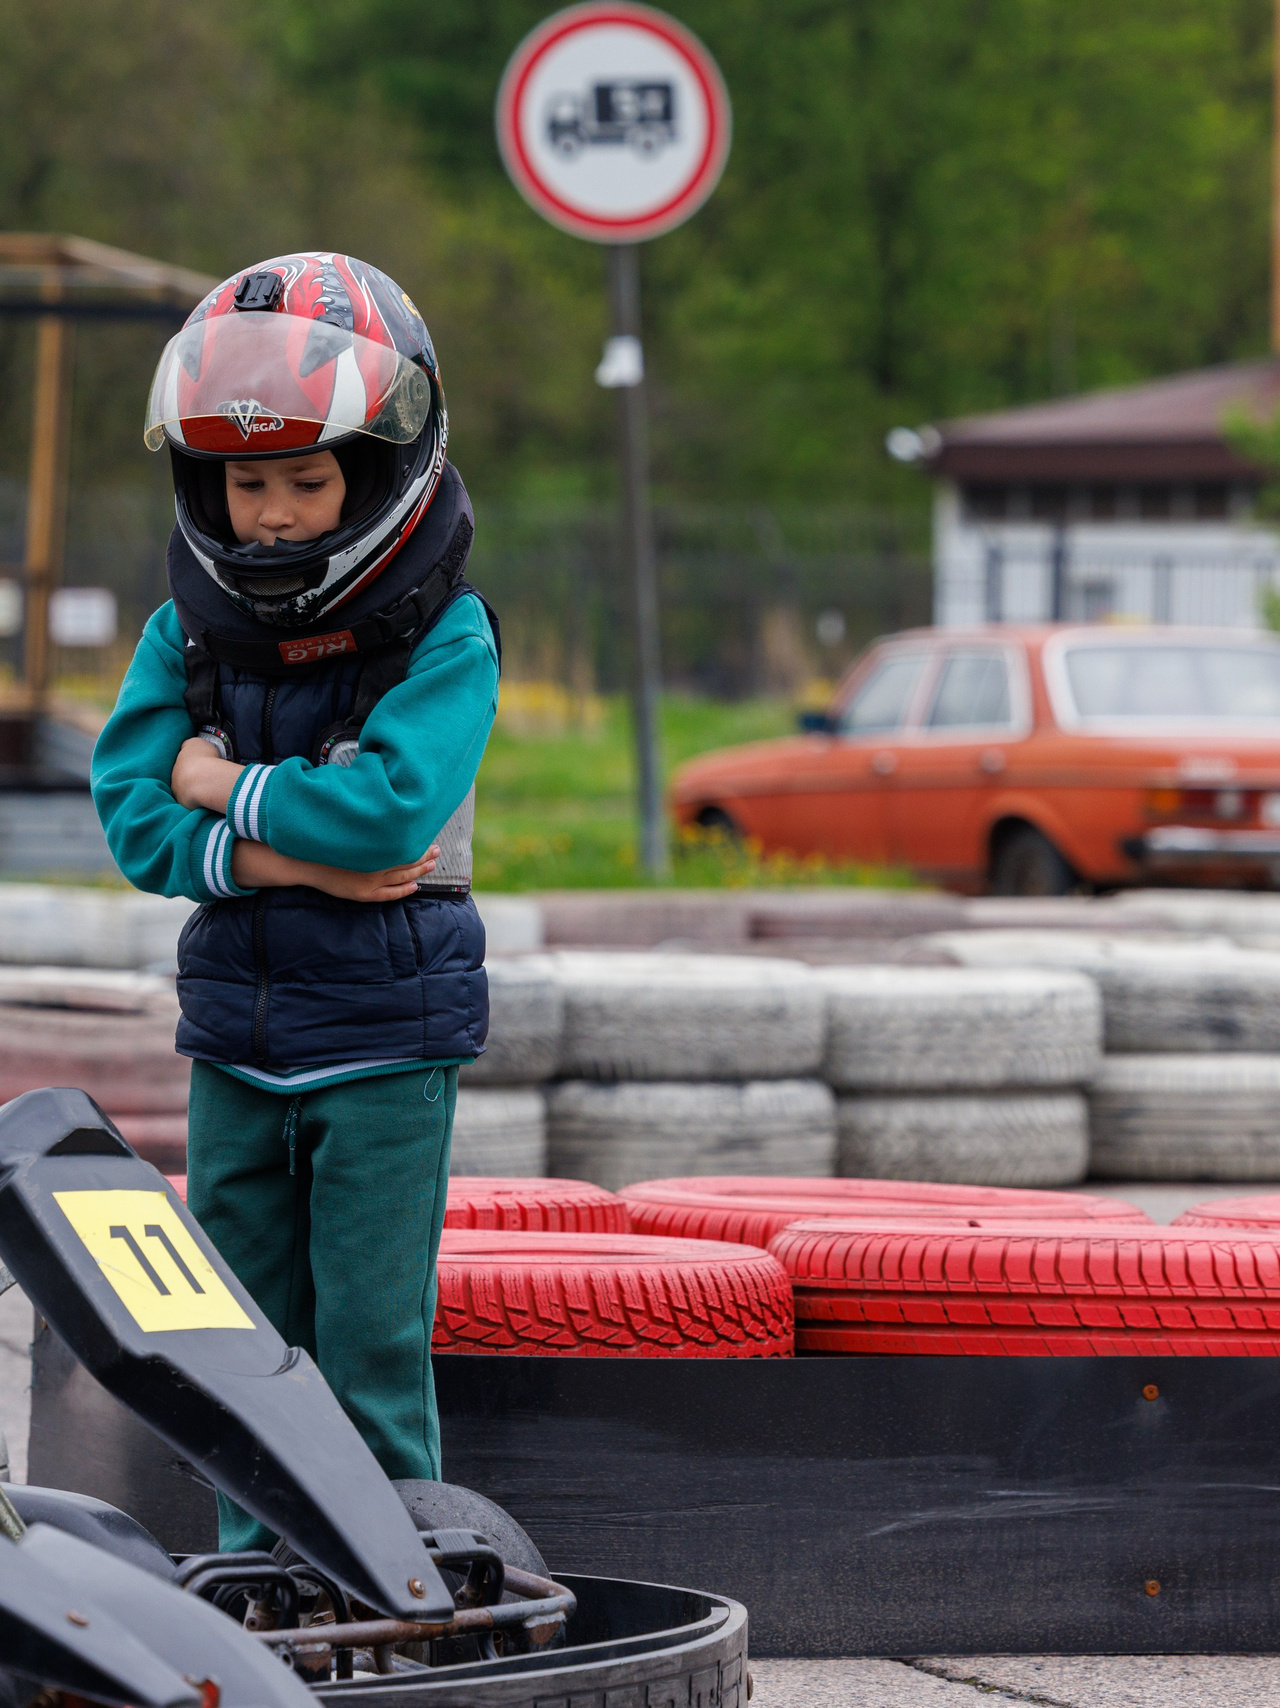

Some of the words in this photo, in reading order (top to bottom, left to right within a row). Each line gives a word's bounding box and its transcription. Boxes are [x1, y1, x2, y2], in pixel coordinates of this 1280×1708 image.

[245, 422, 277, 433] VEGA
[288, 640, 347, 661] RLG
[109, 1224, 206, 1296] 11
